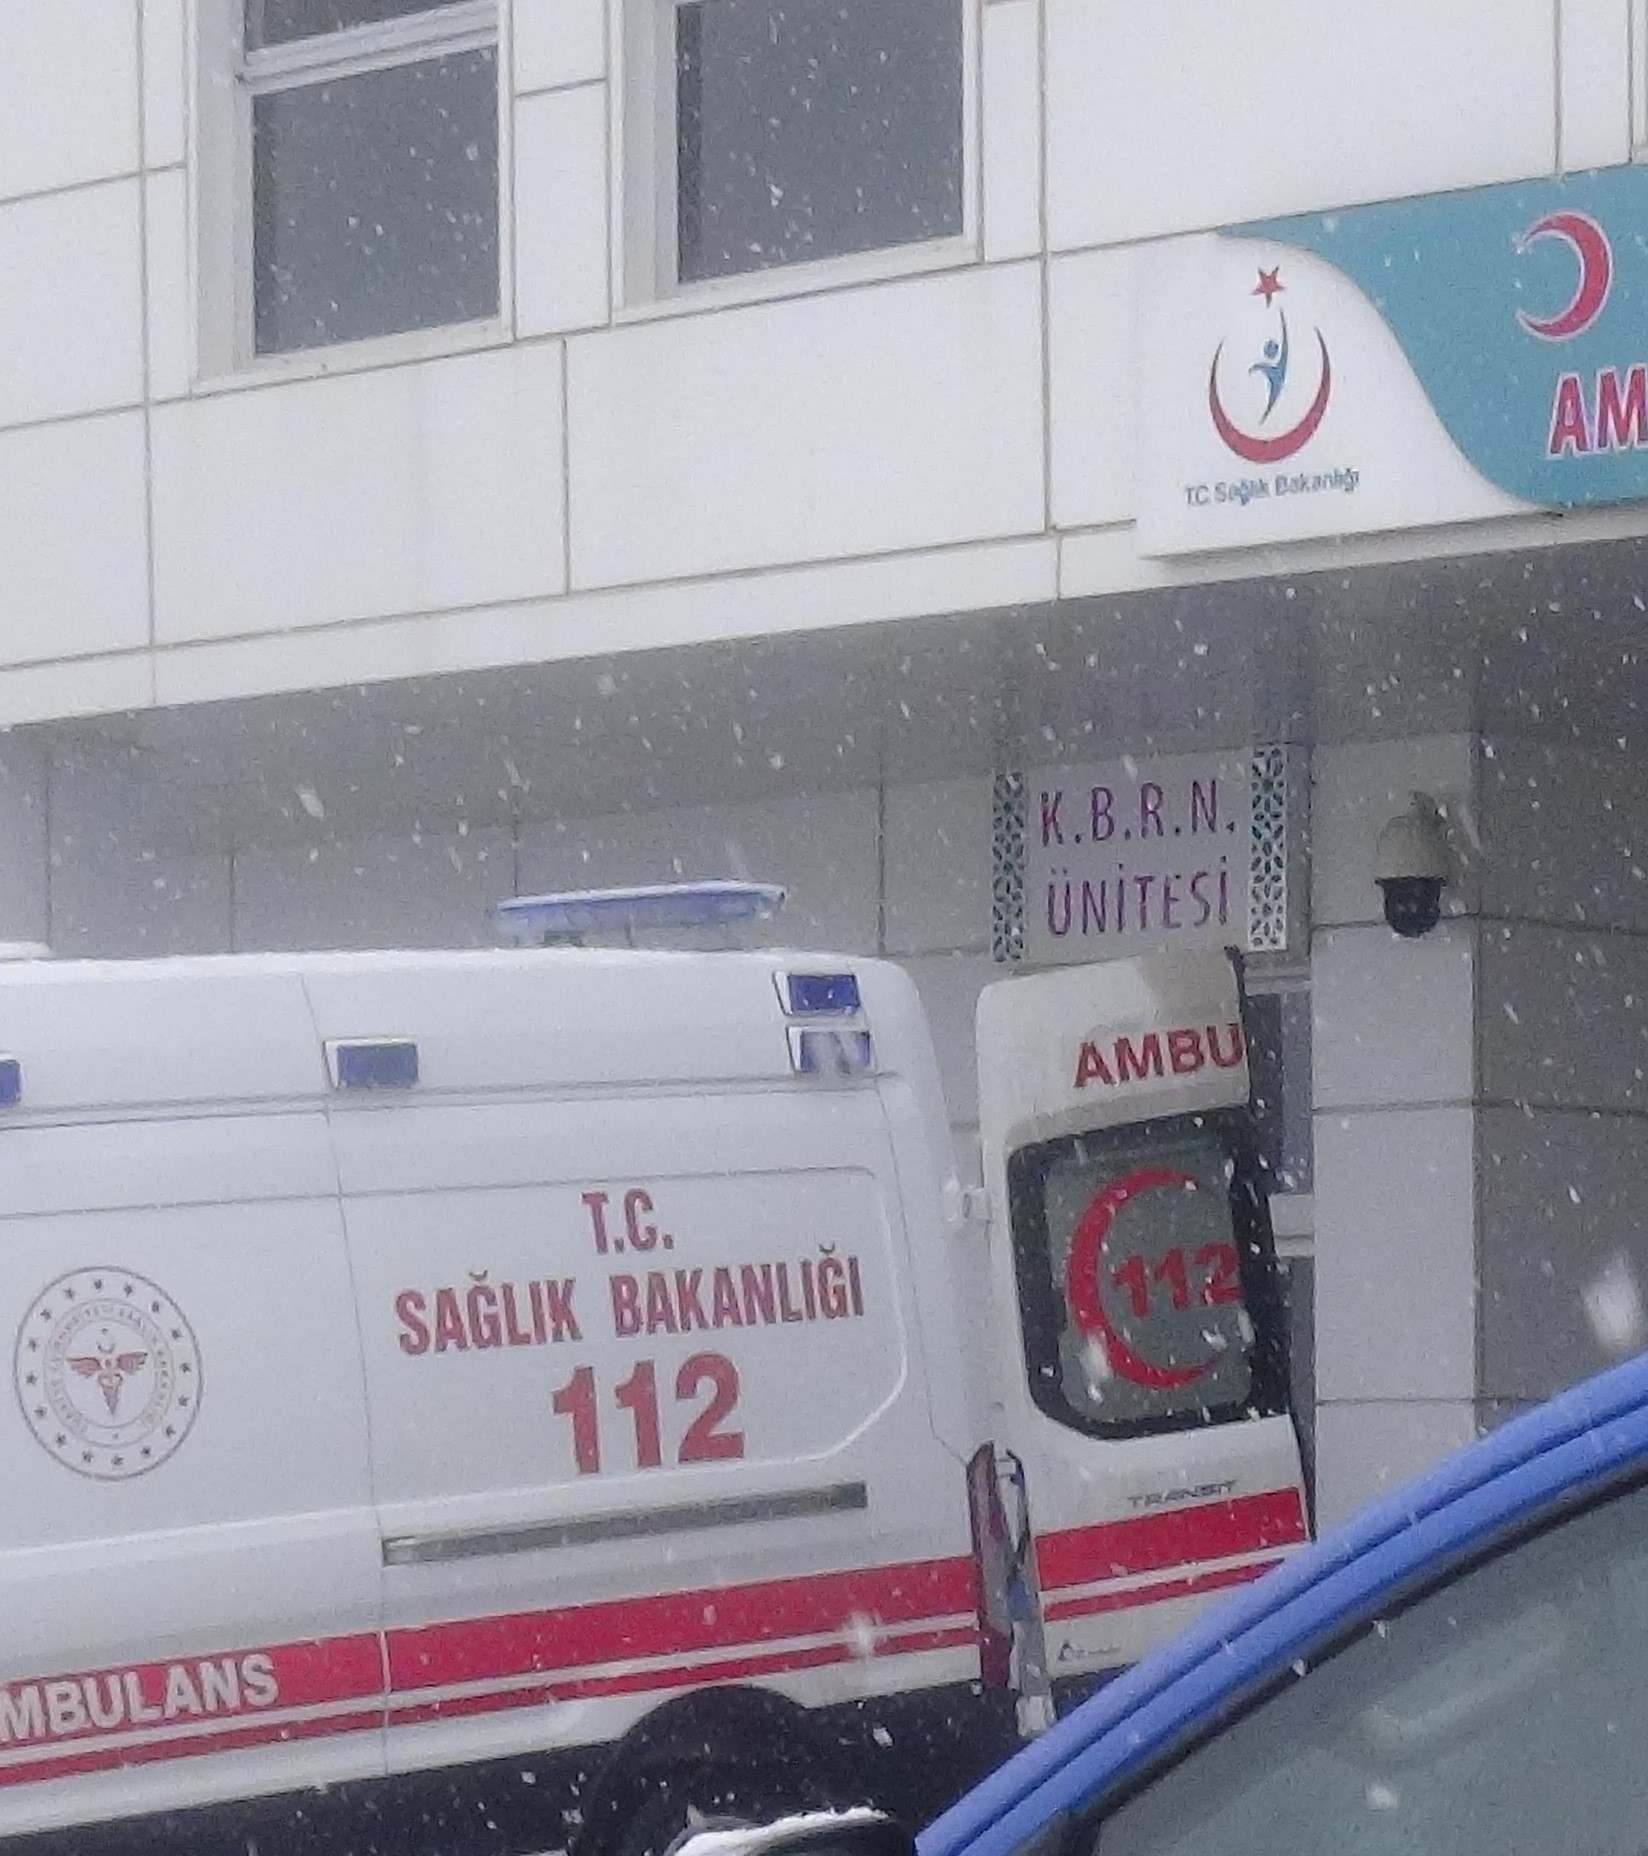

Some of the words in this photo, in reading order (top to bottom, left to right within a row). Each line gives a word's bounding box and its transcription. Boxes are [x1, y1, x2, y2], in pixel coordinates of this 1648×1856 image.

[1040, 779, 1235, 847] K.B.R.N.
[1046, 855, 1229, 938] ÜNİTESİ
[580, 1187, 676, 1256] T.C.
[395, 1269, 583, 1356] SAĞLIK
[609, 1243, 865, 1339] BAKANLIĞI
[1111, 1240, 1245, 1320] 112
[552, 1351, 745, 1475] 112
